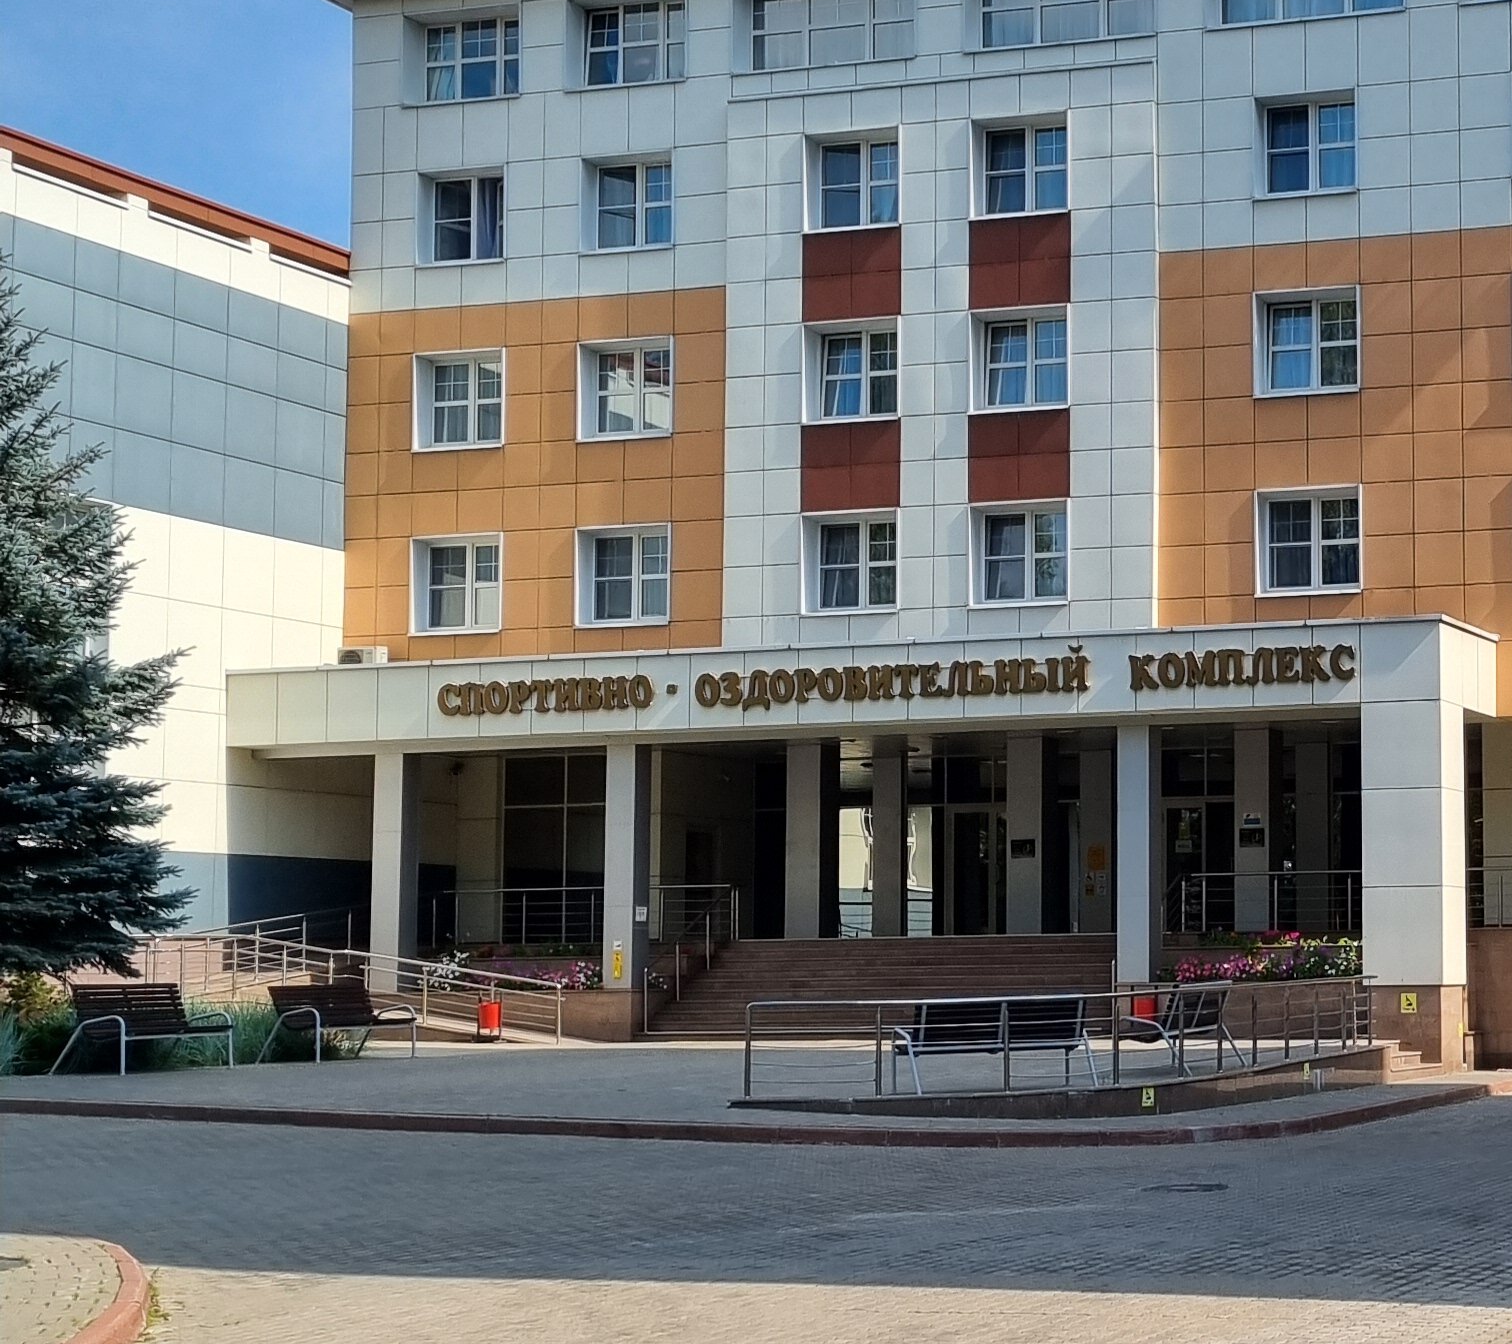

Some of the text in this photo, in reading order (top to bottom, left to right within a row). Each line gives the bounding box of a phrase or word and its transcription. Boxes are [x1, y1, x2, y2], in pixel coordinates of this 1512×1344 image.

[438, 644, 1357, 716] СПОРТИВНО ОЗДОРОВИТЕЛЬНЫЙ КОМПЛЕКС
